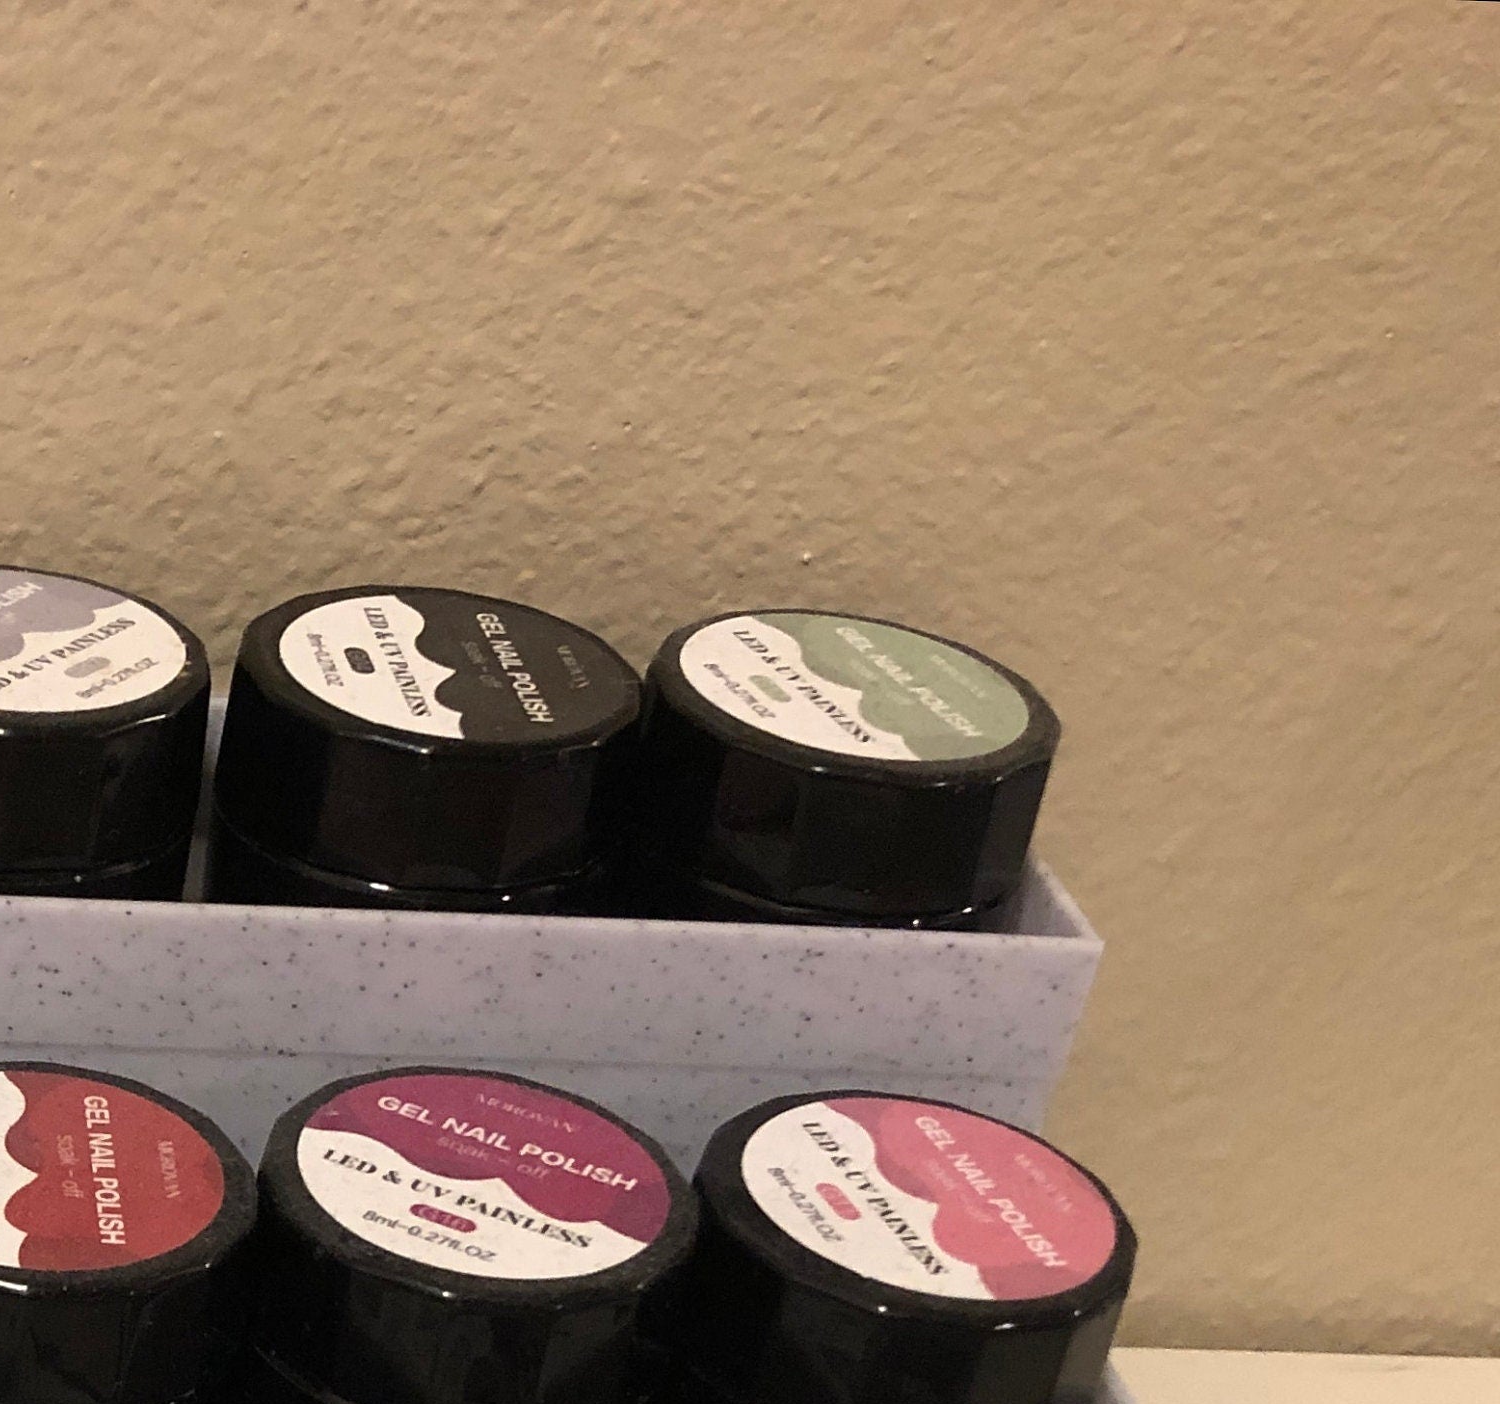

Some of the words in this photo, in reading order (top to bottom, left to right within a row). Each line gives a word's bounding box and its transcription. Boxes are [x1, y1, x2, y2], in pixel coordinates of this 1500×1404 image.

[472, 612, 509, 638] GEL
[3, 667, 32, 680] &
[20, 653, 61, 672] UV
[47, 616, 139, 659] PAINLESS
[486, 639, 527, 670] NAIL
[504, 671, 556, 722] POLISH
[81, 1094, 111, 1130] GEL
[54, 1133, 79, 1166] soak
[86, 1131, 117, 1174] NAIL
[372, 1094, 442, 1125] GEL
[438, 1116, 519, 1151] NAIL
[516, 1142, 641, 1192] POLISH
[799, 1121, 844, 1153] LED
[828, 1154, 857, 1168] &
[61, 1180, 84, 1199] off
[319, 1148, 381, 1176] LED
[379, 1168, 408, 1185] &
[407, 1178, 457, 1202] UV
[452, 1193, 595, 1250] PAINLESS
[842, 1170, 881, 1196] UV
[909, 1116, 963, 1151] GEL
[943, 1153, 1003, 1195] NAIL
[983, 1197, 1069, 1266] POLISH
[91, 1176, 127, 1246] POLISH
[864, 1196, 951, 1276] PAINLESS
